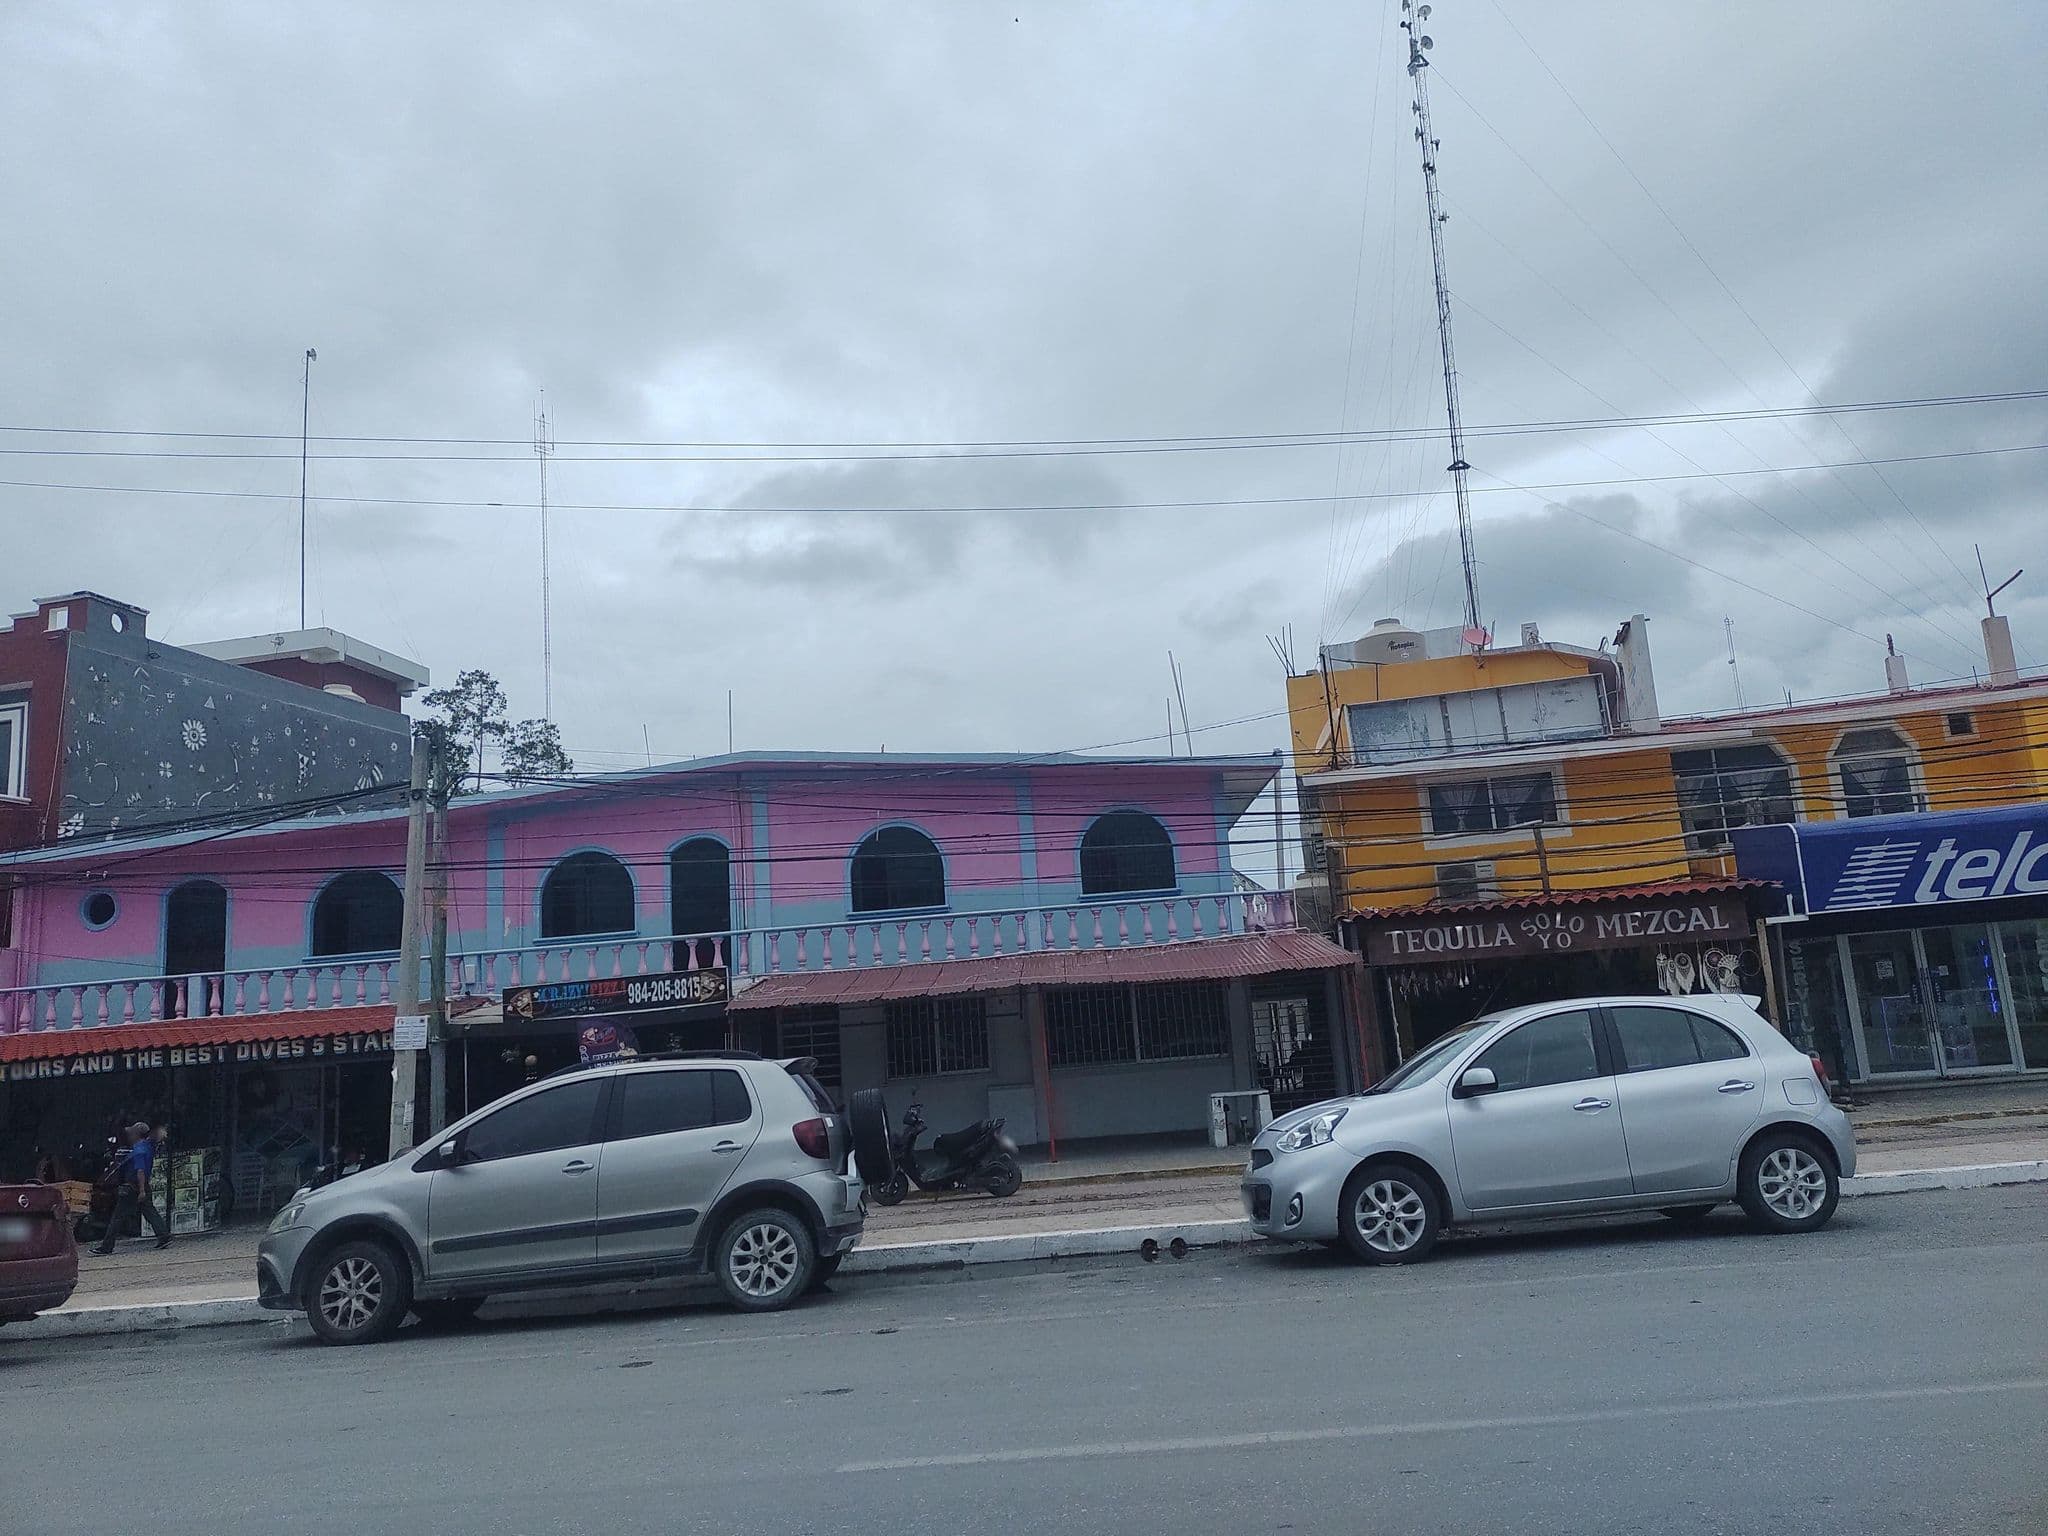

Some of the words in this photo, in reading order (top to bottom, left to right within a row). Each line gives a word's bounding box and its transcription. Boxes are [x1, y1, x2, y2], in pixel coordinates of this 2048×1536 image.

[1385, 923, 1515, 954] TEQUILA
[1521, 912, 1585, 937] SOLO
[1596, 906, 1730, 939] MEZCAL
[1537, 931, 1572, 949] YO
[628, 977, 700, 1004] 984-205-8815
[71, 1054, 115, 1074] AND
[122, 1049, 163, 1070] THE
[170, 1045, 227, 1065] BEST
[236, 1039, 305, 1061] DIVES
[312, 1037, 325, 1055] 5
